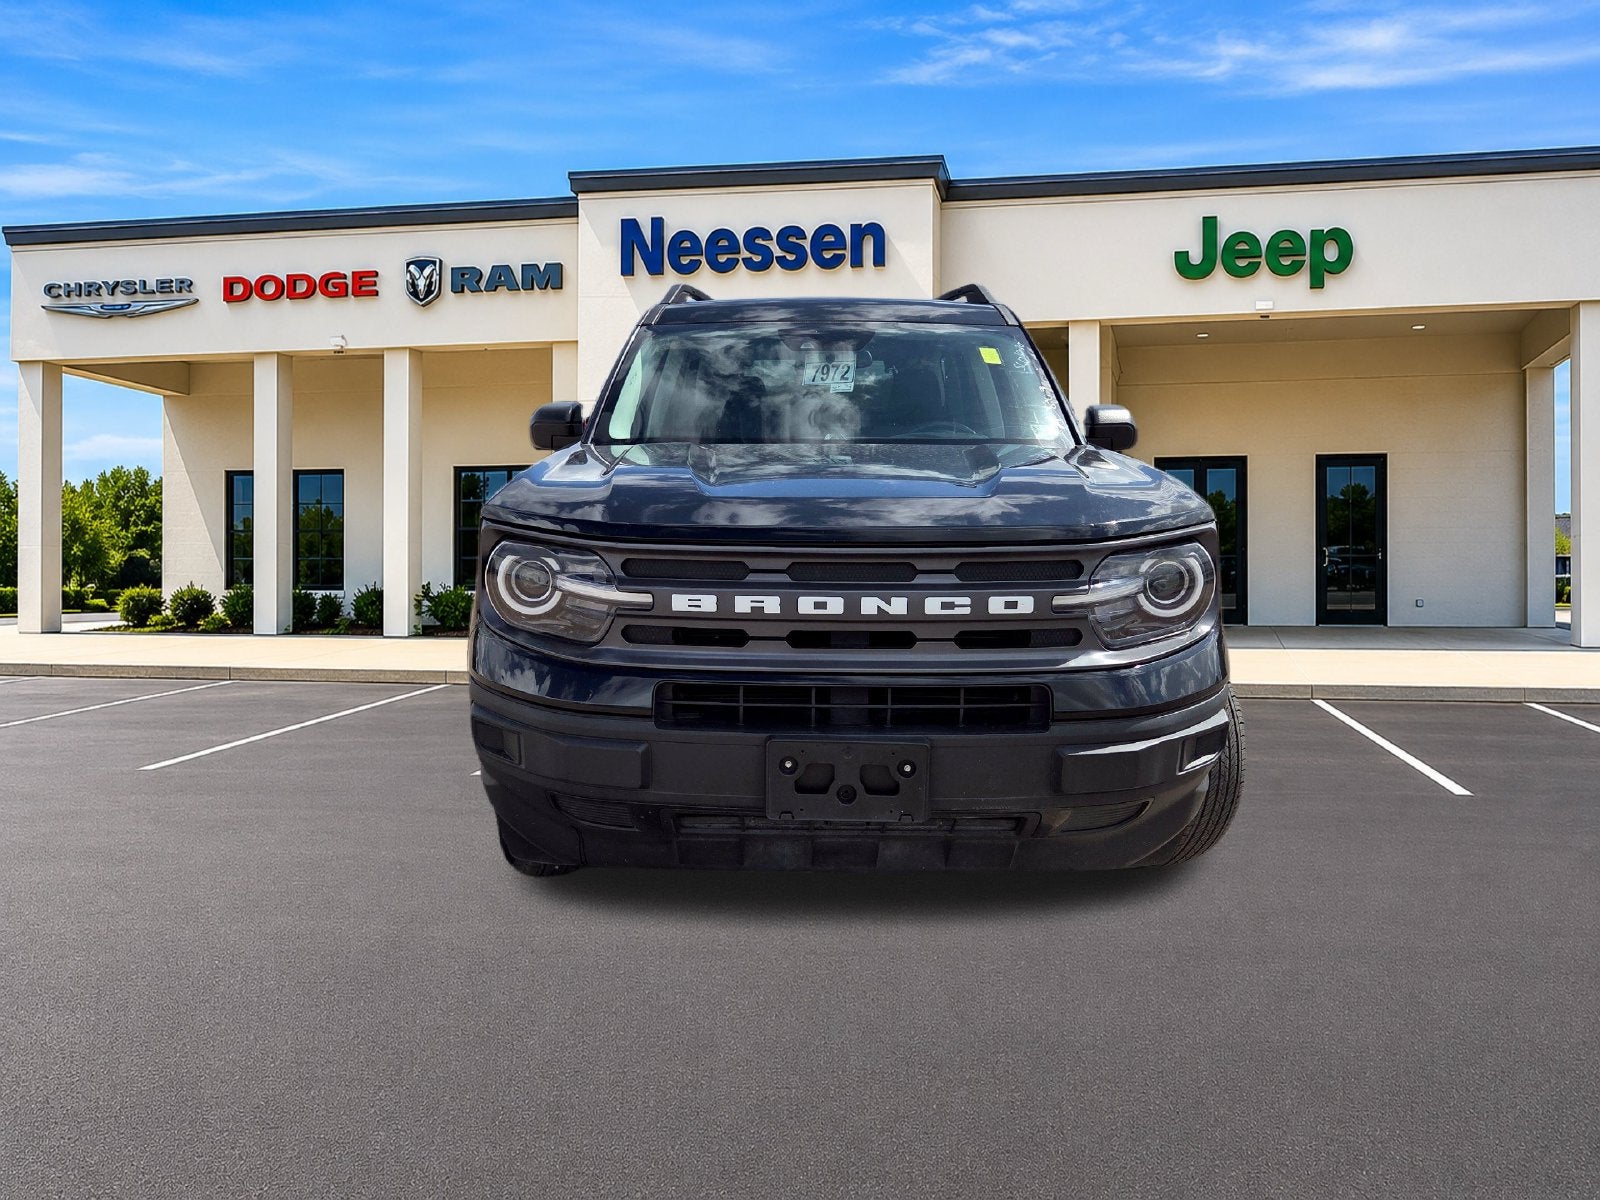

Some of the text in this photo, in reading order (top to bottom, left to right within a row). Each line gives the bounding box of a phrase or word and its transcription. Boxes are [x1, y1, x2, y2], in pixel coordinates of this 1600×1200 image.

[620, 217, 887, 277] Neessen
[1174, 215, 1354, 289] Jeep
[43, 277, 194, 299] CHRYSLER
[222, 269, 379, 302] DODGE
[450, 262, 563, 294] RAM
[811, 363, 850, 382] 7972
[671, 593, 1035, 615] BRONCO
